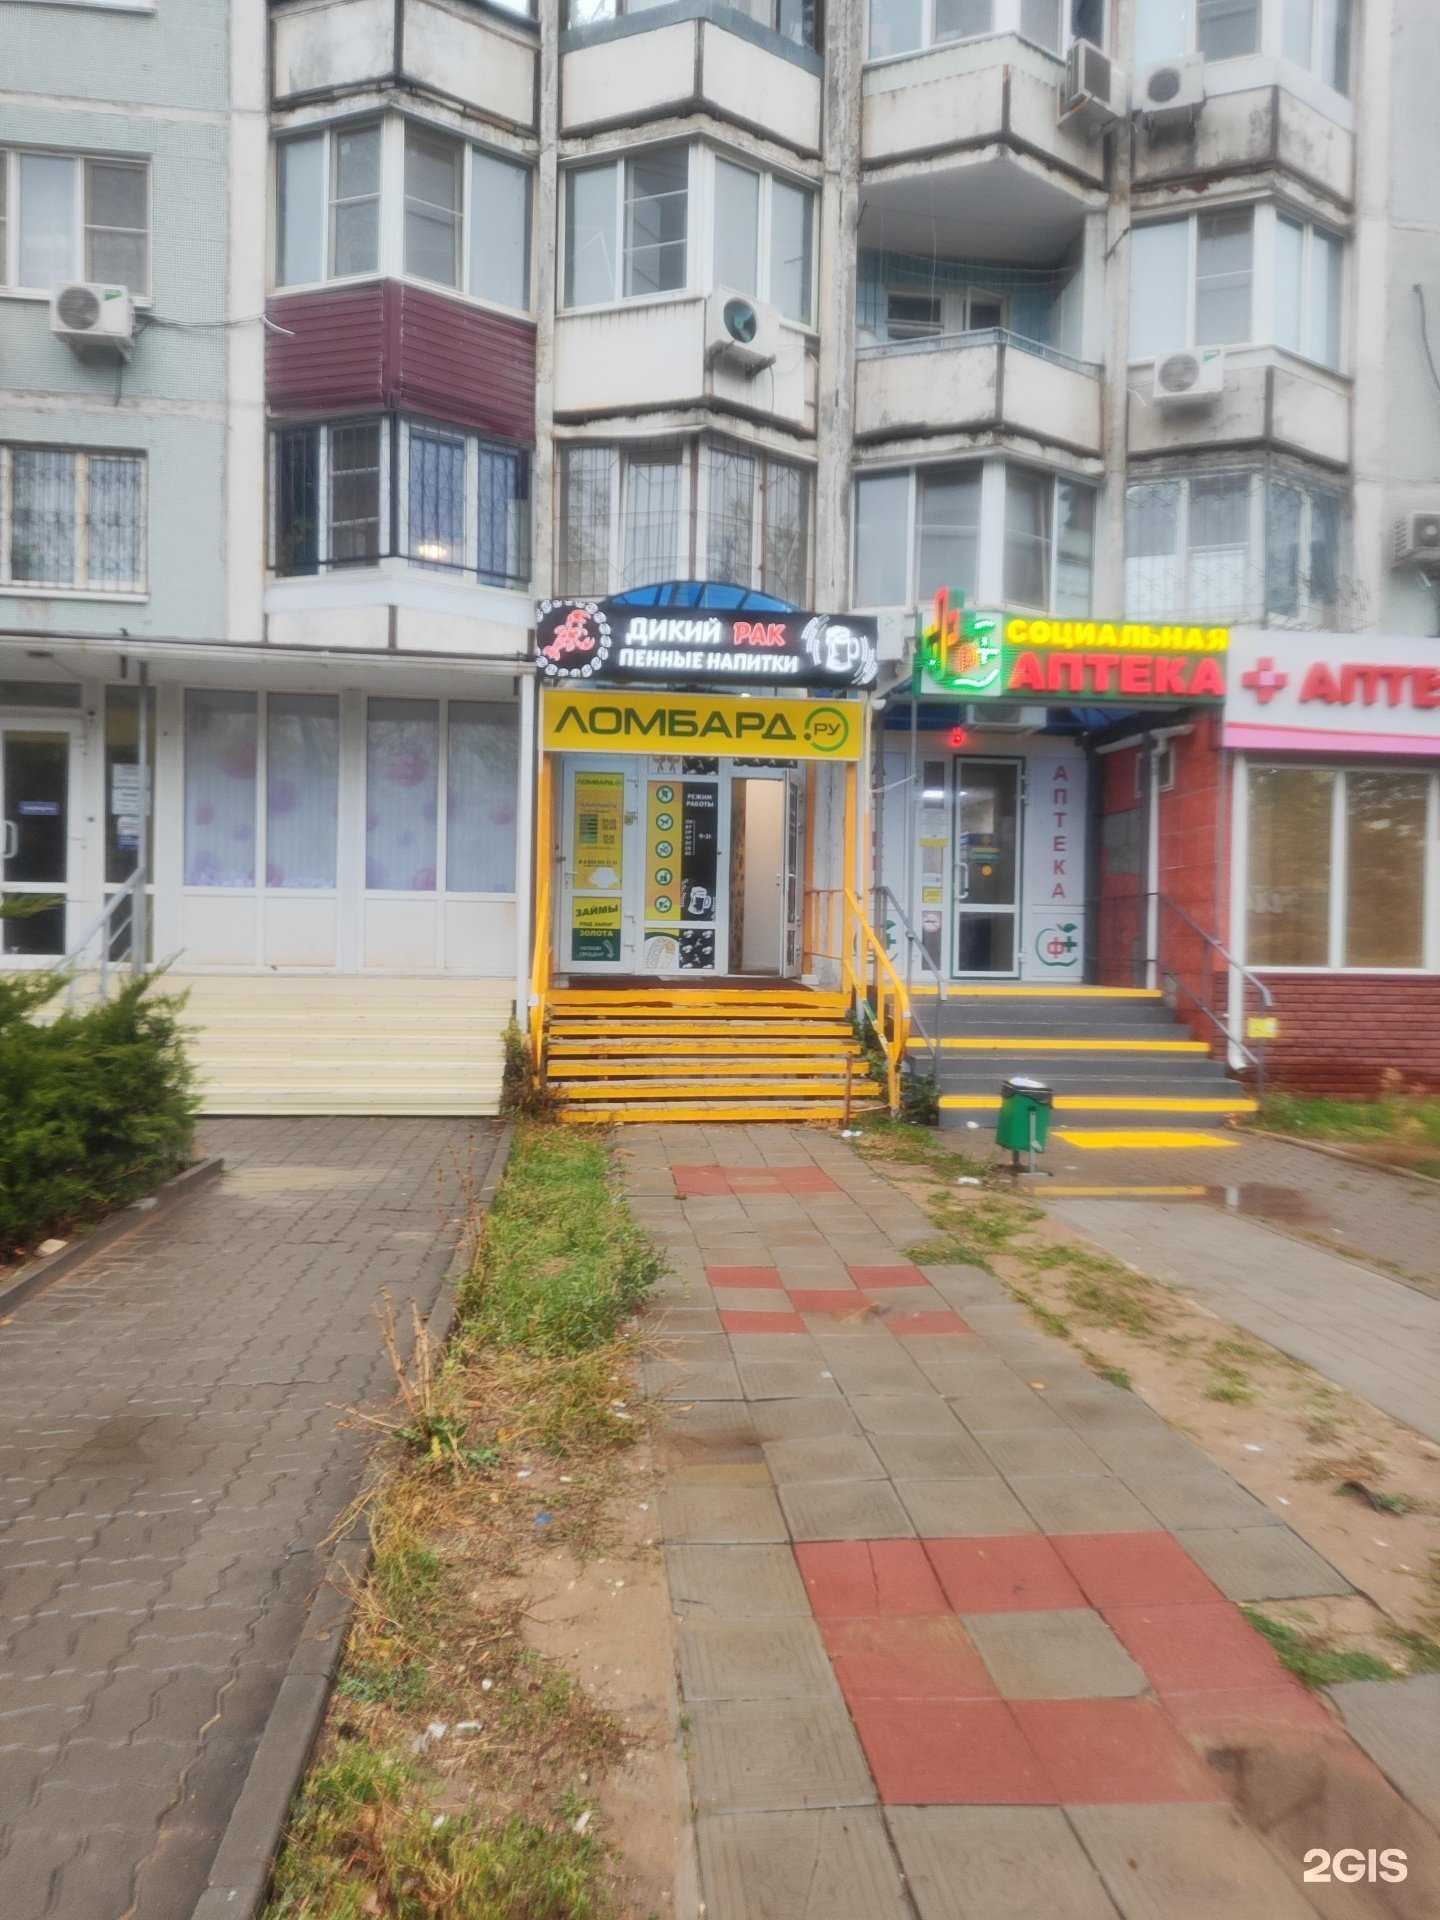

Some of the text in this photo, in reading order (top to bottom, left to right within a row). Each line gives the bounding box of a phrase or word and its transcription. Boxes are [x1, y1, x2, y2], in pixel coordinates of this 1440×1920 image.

[625, 617, 786, 647] ДИКИЙ РАК
[1006, 618, 1230, 651] СОЦИАЛЬНАЯ
[619, 648, 799, 673] ПЕННЫЕ НАПИТКИ
[1007, 650, 1227, 697] АПТЕКА
[1052, 765, 1069, 899] АПТЕКА
[575, 904, 618, 917] ЗАЙМЫ
